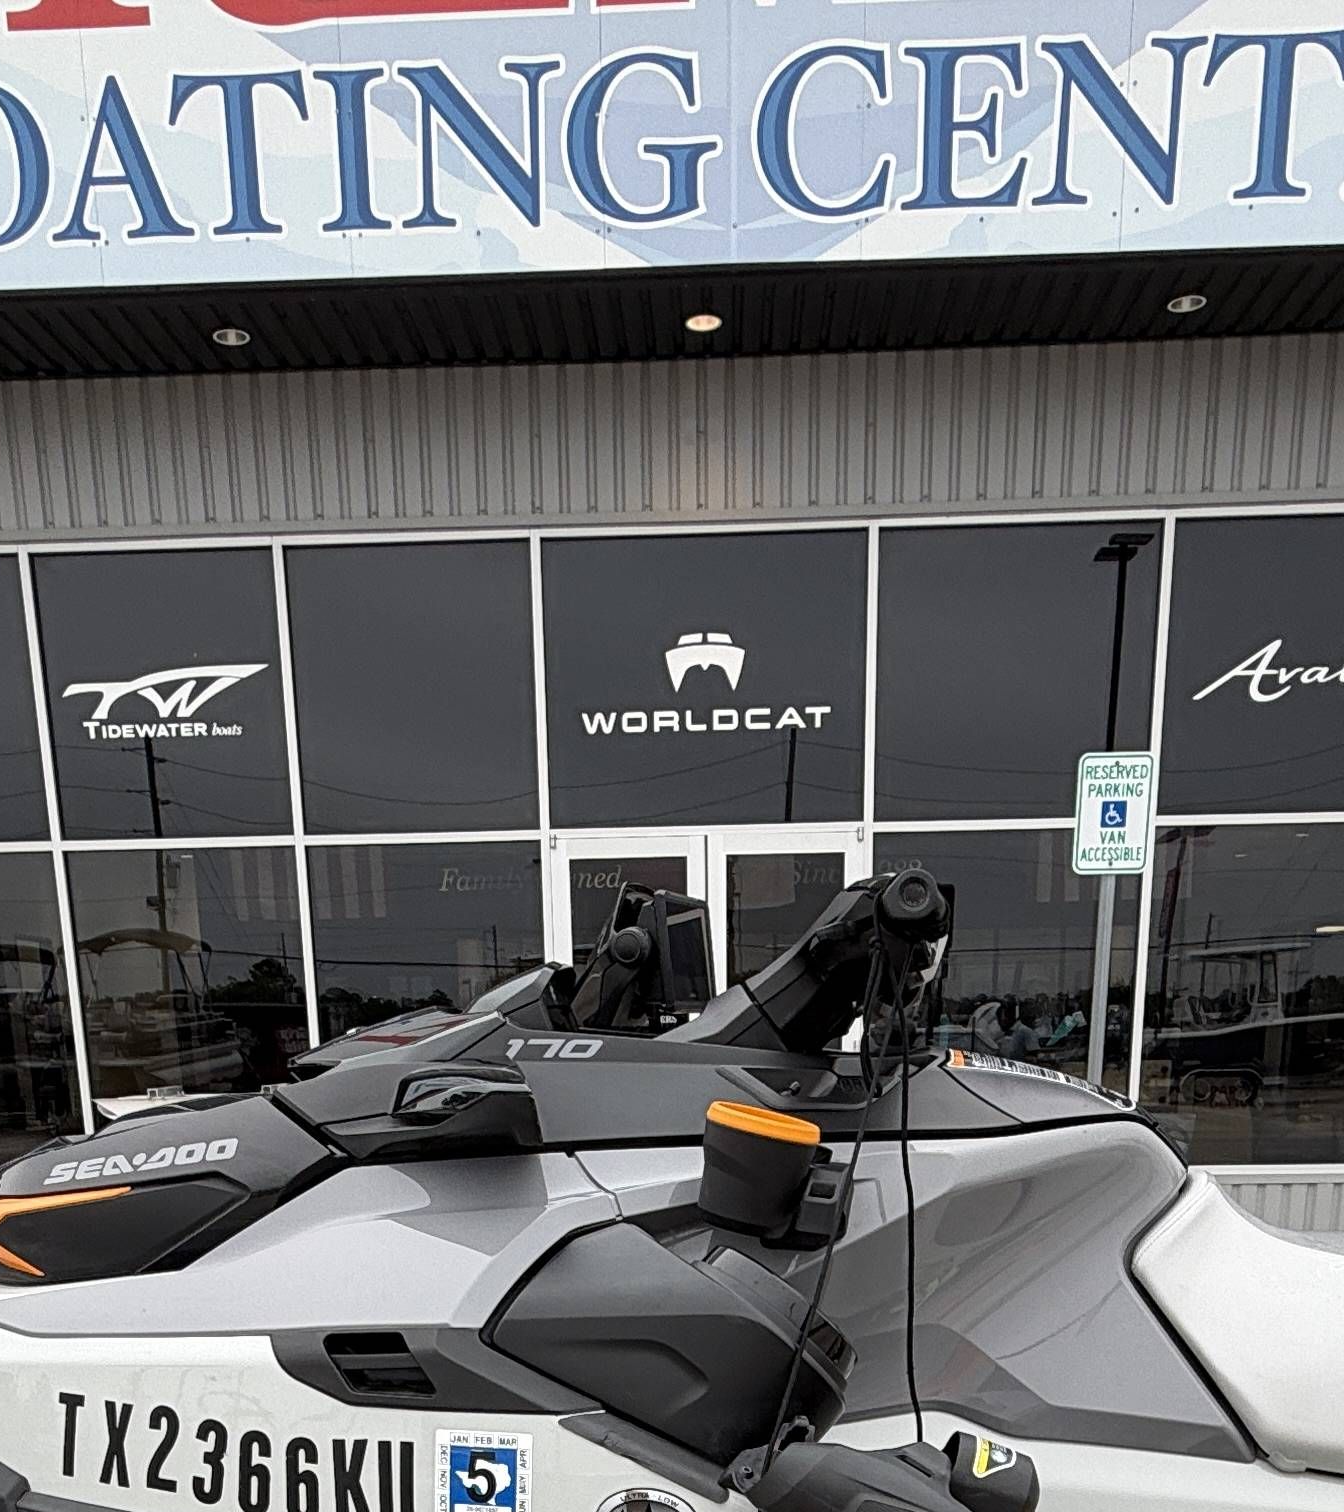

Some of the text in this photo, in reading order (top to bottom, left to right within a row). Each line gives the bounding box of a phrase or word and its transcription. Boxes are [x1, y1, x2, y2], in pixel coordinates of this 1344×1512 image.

[582, 706, 831, 734] WORLDCAT
[212, 722, 243, 736] boats
[1085, 764, 1149, 780] RESERVED
[1088, 782, 1144, 798] PARKING
[1100, 830, 1126, 845] VAN
[1080, 846, 1143, 861] ACCESSIBLE
[506, 1038, 603, 1059] 170
[453, 1435, 517, 1446] JAN FEB MAR
[520, 1449, 528, 1468] APR
[465, 1451, 497, 1503] 5
